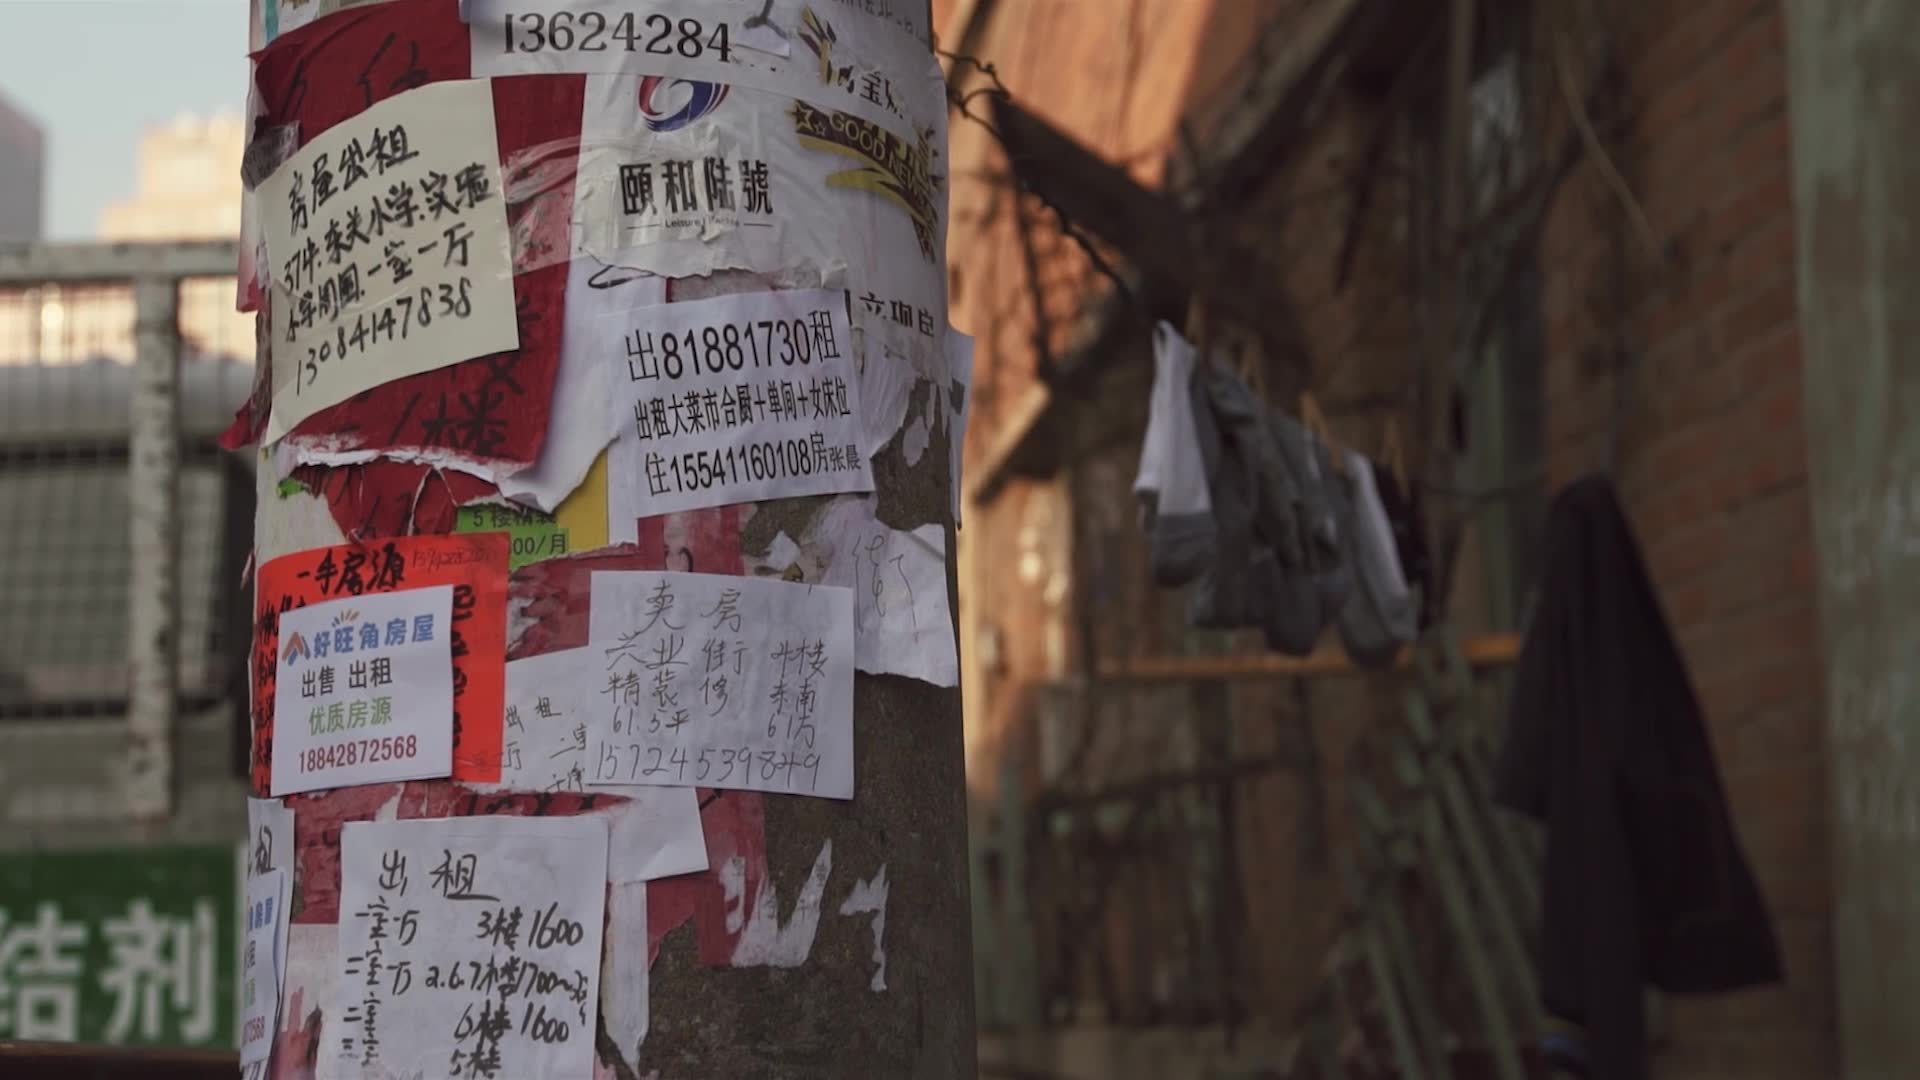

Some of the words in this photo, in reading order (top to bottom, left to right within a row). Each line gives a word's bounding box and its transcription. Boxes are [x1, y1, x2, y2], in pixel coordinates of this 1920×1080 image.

[829, 110, 886, 161] GOOD
[296, 276, 472, 397] 13084147838
[625, 309, 840, 382] 出81881730租
[313, 613, 434, 659] 好旺角房屋
[301, 665, 335, 699] 出售
[349, 656, 393, 690] 出租
[308, 696, 393, 737] 优质房源
[299, 734, 418, 775] 18842872568
[597, 739, 822, 791] 15724539849
